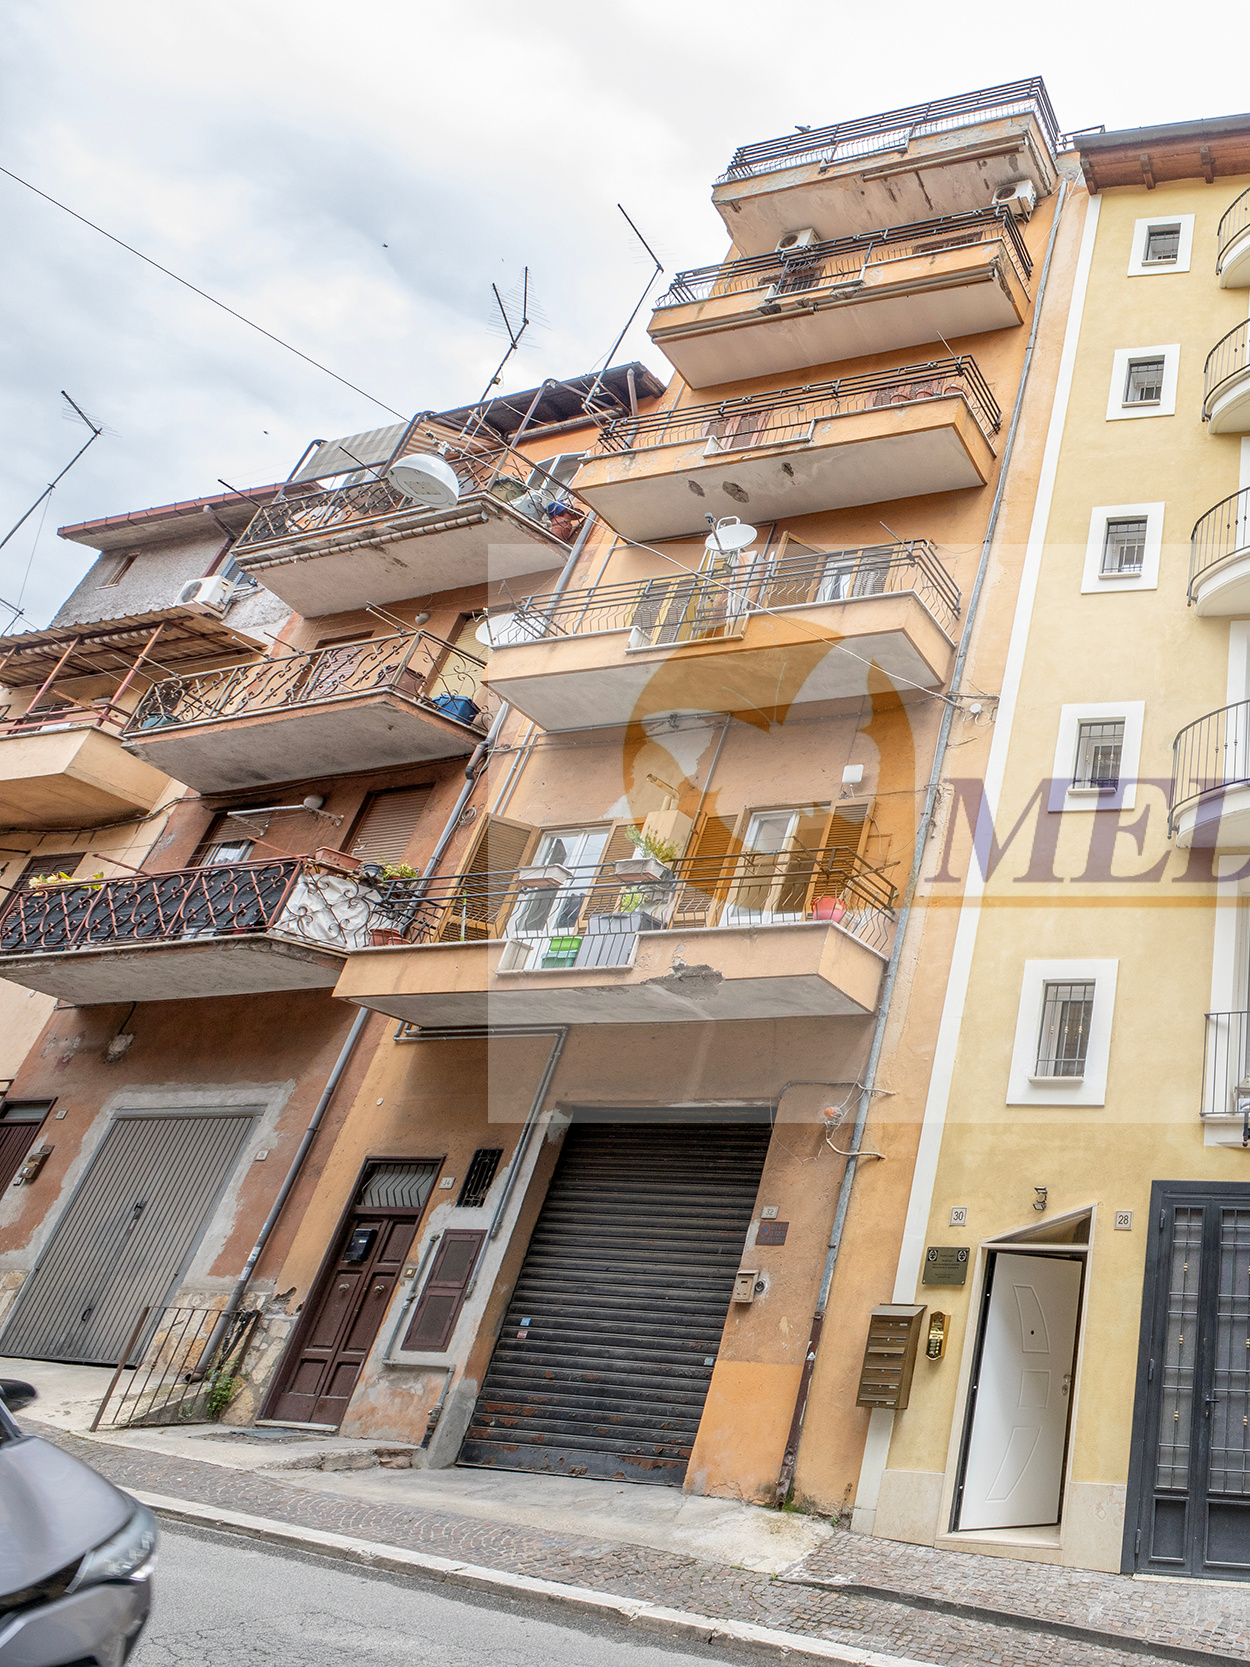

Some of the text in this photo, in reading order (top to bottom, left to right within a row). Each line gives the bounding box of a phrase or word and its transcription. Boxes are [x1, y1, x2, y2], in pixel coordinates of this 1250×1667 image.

[766, 1208, 775, 1216] 32
[953, 1210, 964, 1221] 30
[1118, 1214, 1130, 1225] 28
